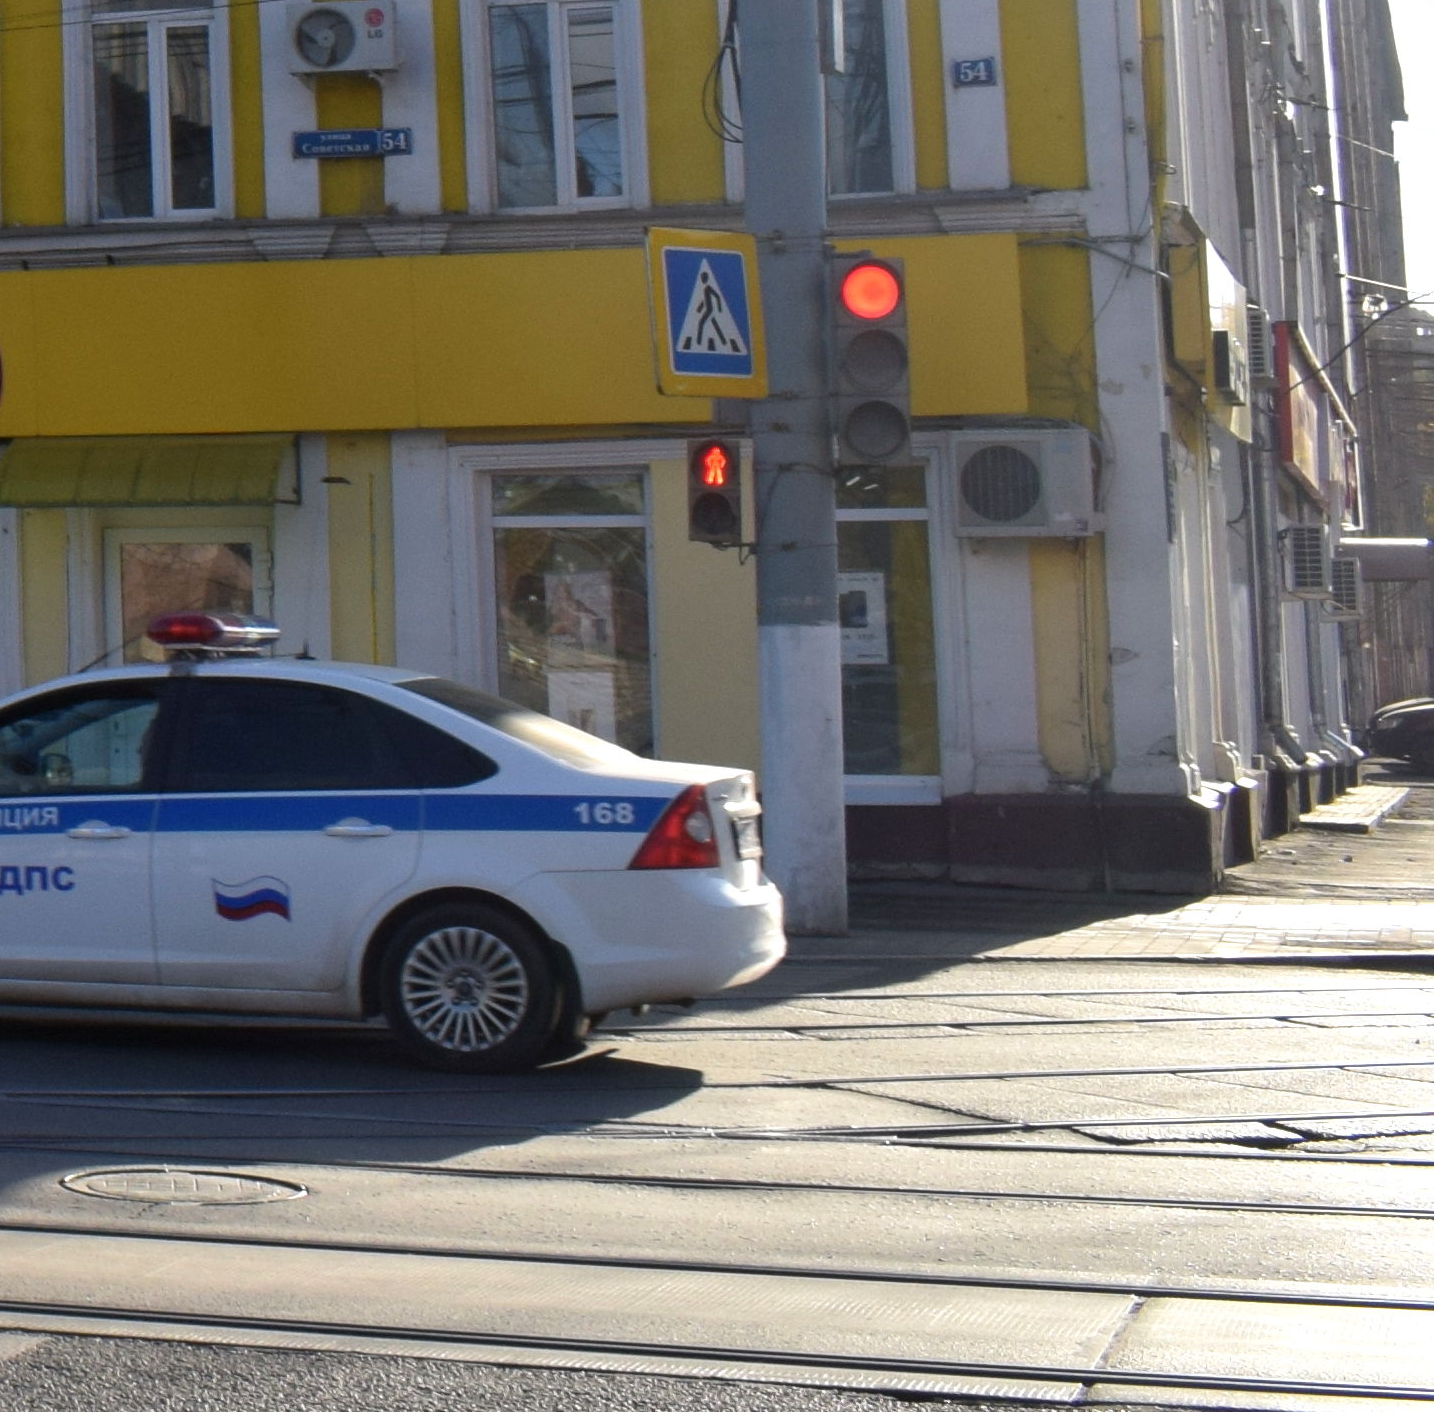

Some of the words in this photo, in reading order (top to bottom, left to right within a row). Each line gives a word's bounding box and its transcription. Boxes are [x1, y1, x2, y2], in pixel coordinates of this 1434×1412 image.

[367, 29, 384, 39] LG
[959, 61, 989, 82] 54
[320, 131, 352, 141] улица
[382, 132, 407, 152] 54
[301, 140, 371, 155] Советская
[573, 801, 636, 825] 168
